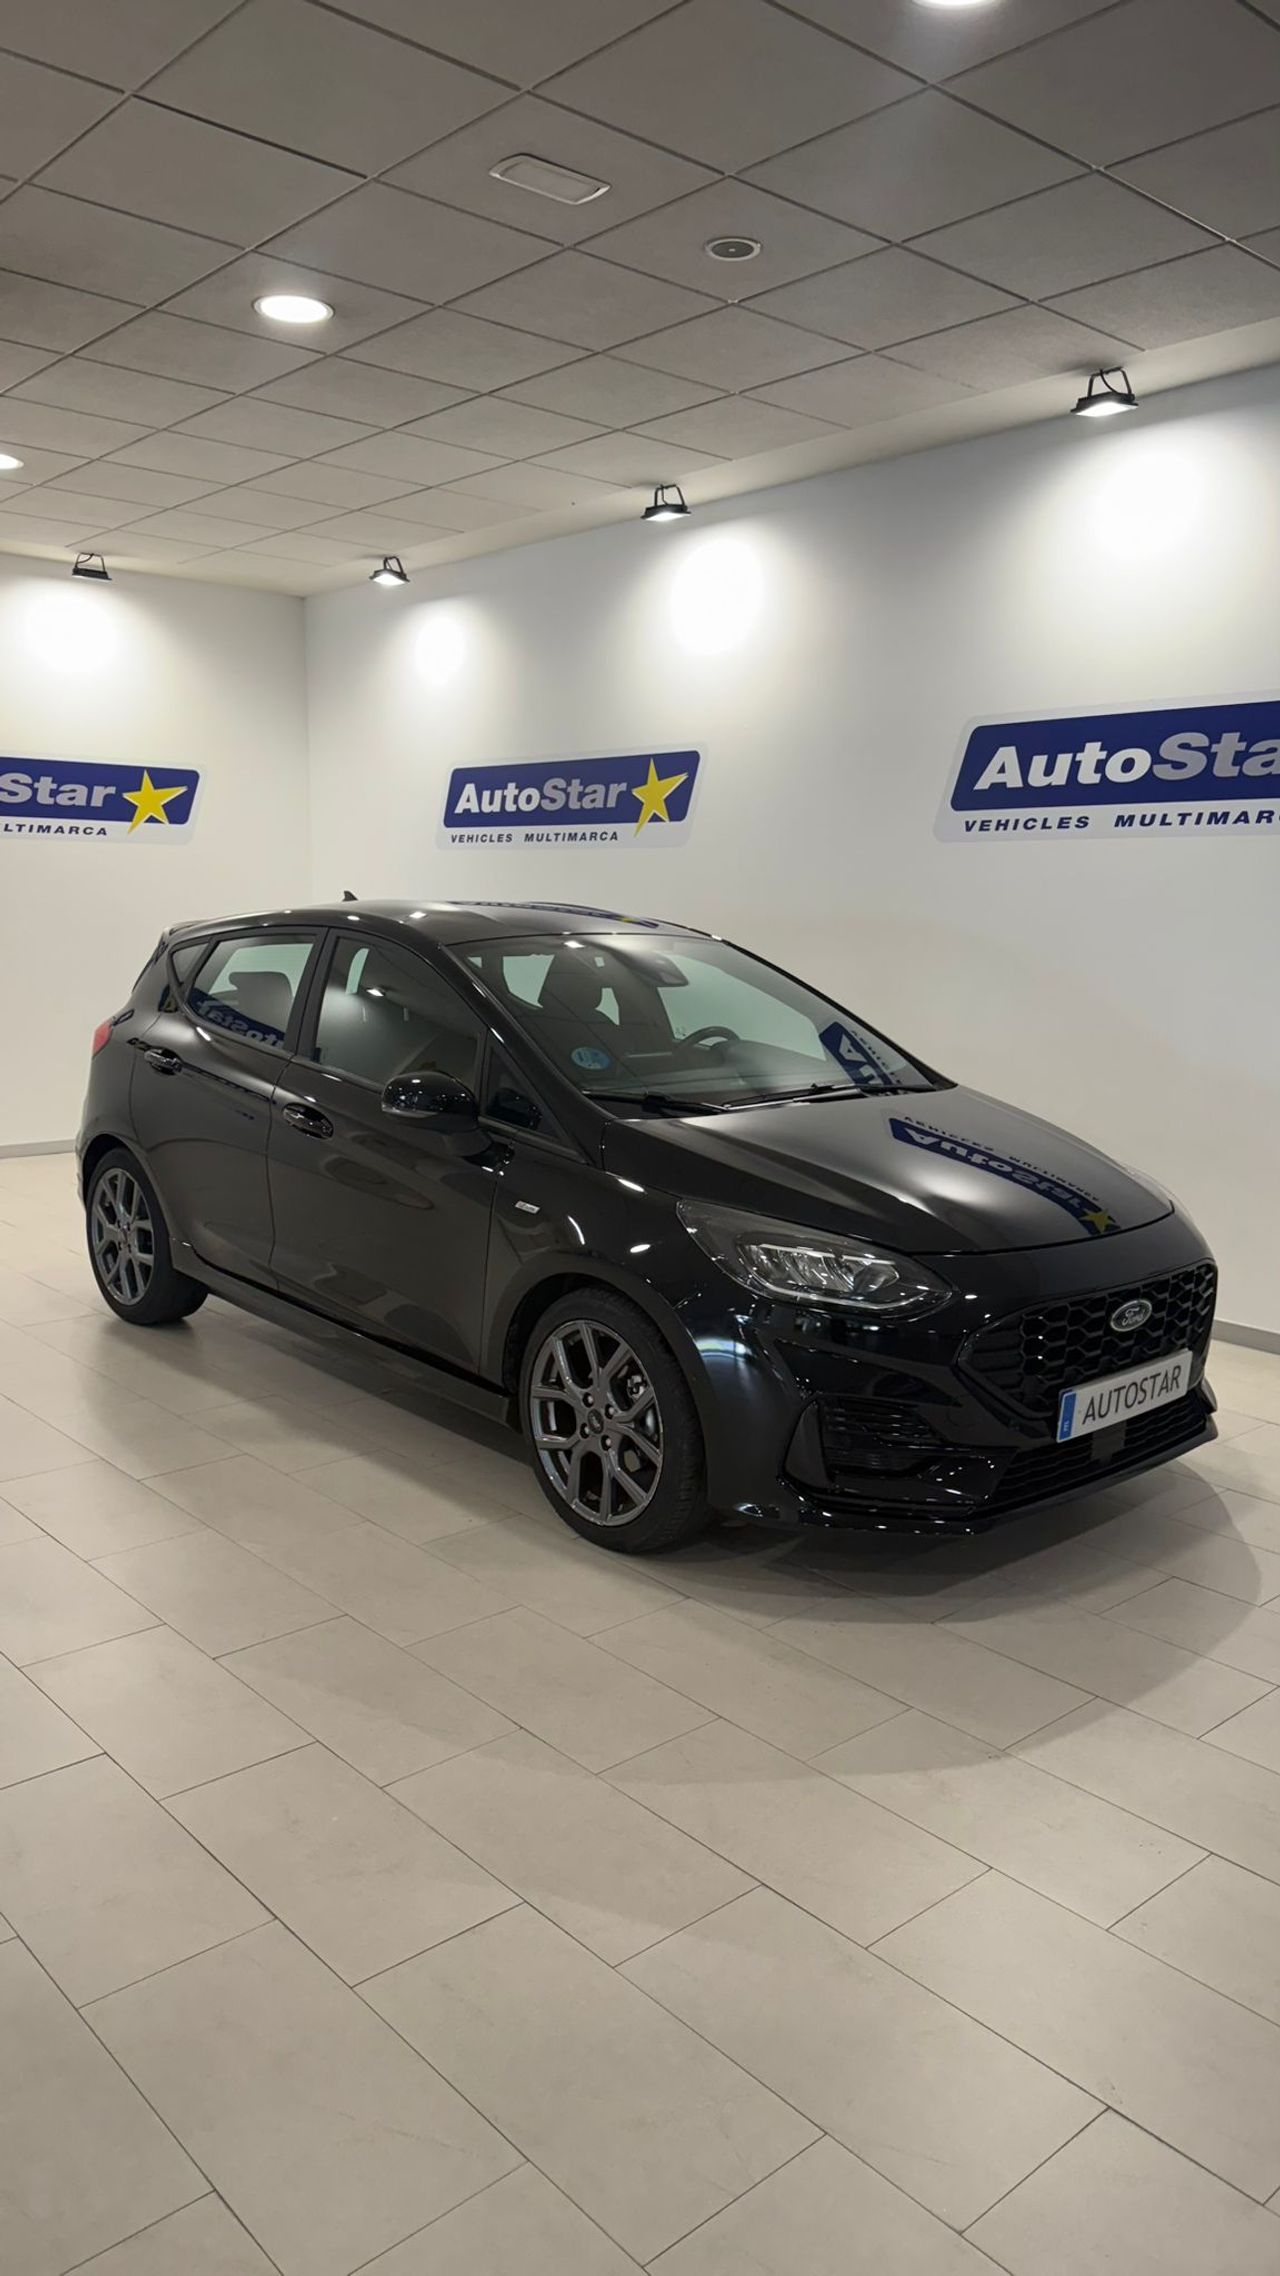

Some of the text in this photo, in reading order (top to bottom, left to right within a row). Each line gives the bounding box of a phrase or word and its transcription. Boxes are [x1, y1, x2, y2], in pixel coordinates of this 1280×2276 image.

[973, 731, 1280, 791] AutoSta
[0, 772, 116, 808] Star
[454, 777, 628, 814] AutoStar
[0, 822, 108, 836] LTIMARCA
[450, 830, 619, 844] VEHICLES MULTIMARCA
[964, 809, 1280, 833] VEHICLES MULTIMAR
[1081, 1364, 1182, 1426] AUTOSTAR
